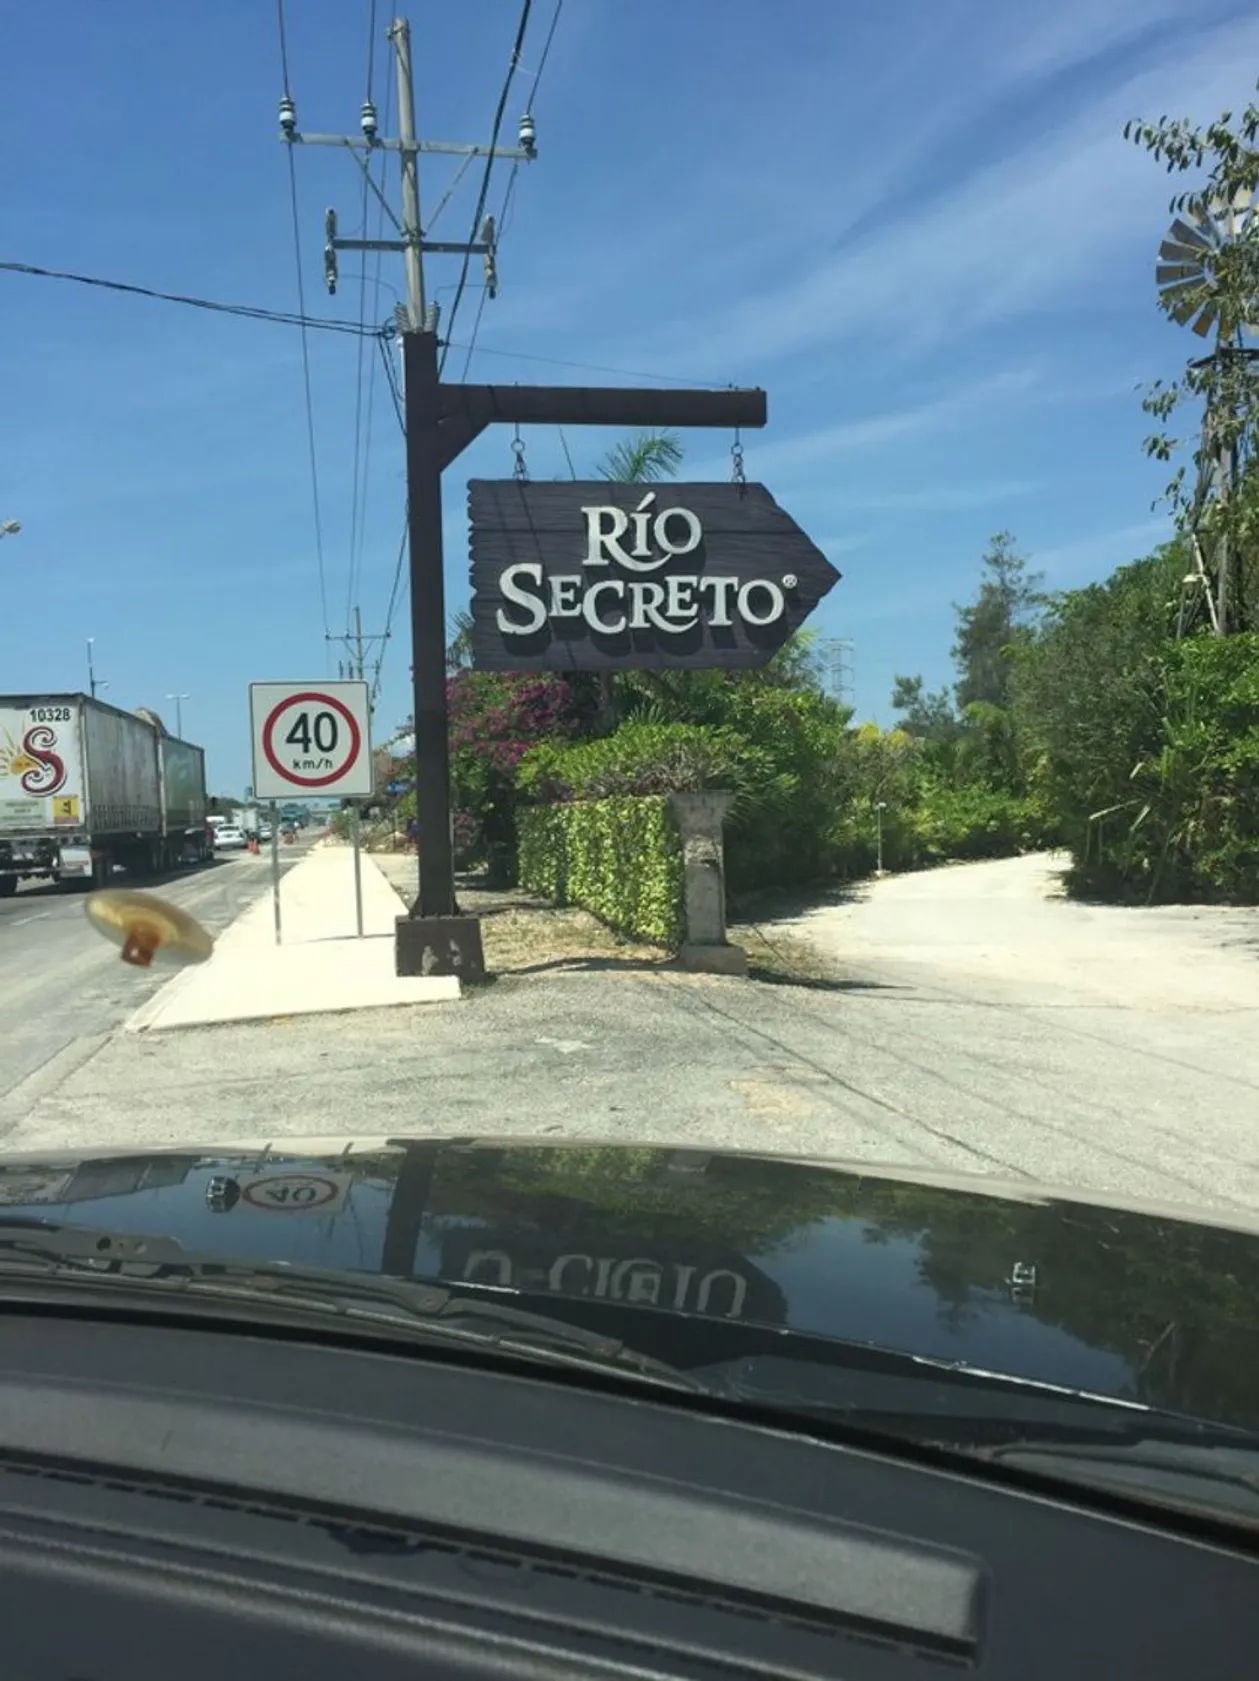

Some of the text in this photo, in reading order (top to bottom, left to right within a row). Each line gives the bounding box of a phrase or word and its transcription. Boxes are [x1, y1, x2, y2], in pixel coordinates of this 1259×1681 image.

[30, 708, 71, 722] 10328
[286, 711, 338, 753] 40
[292, 758, 333, 770] km/h
